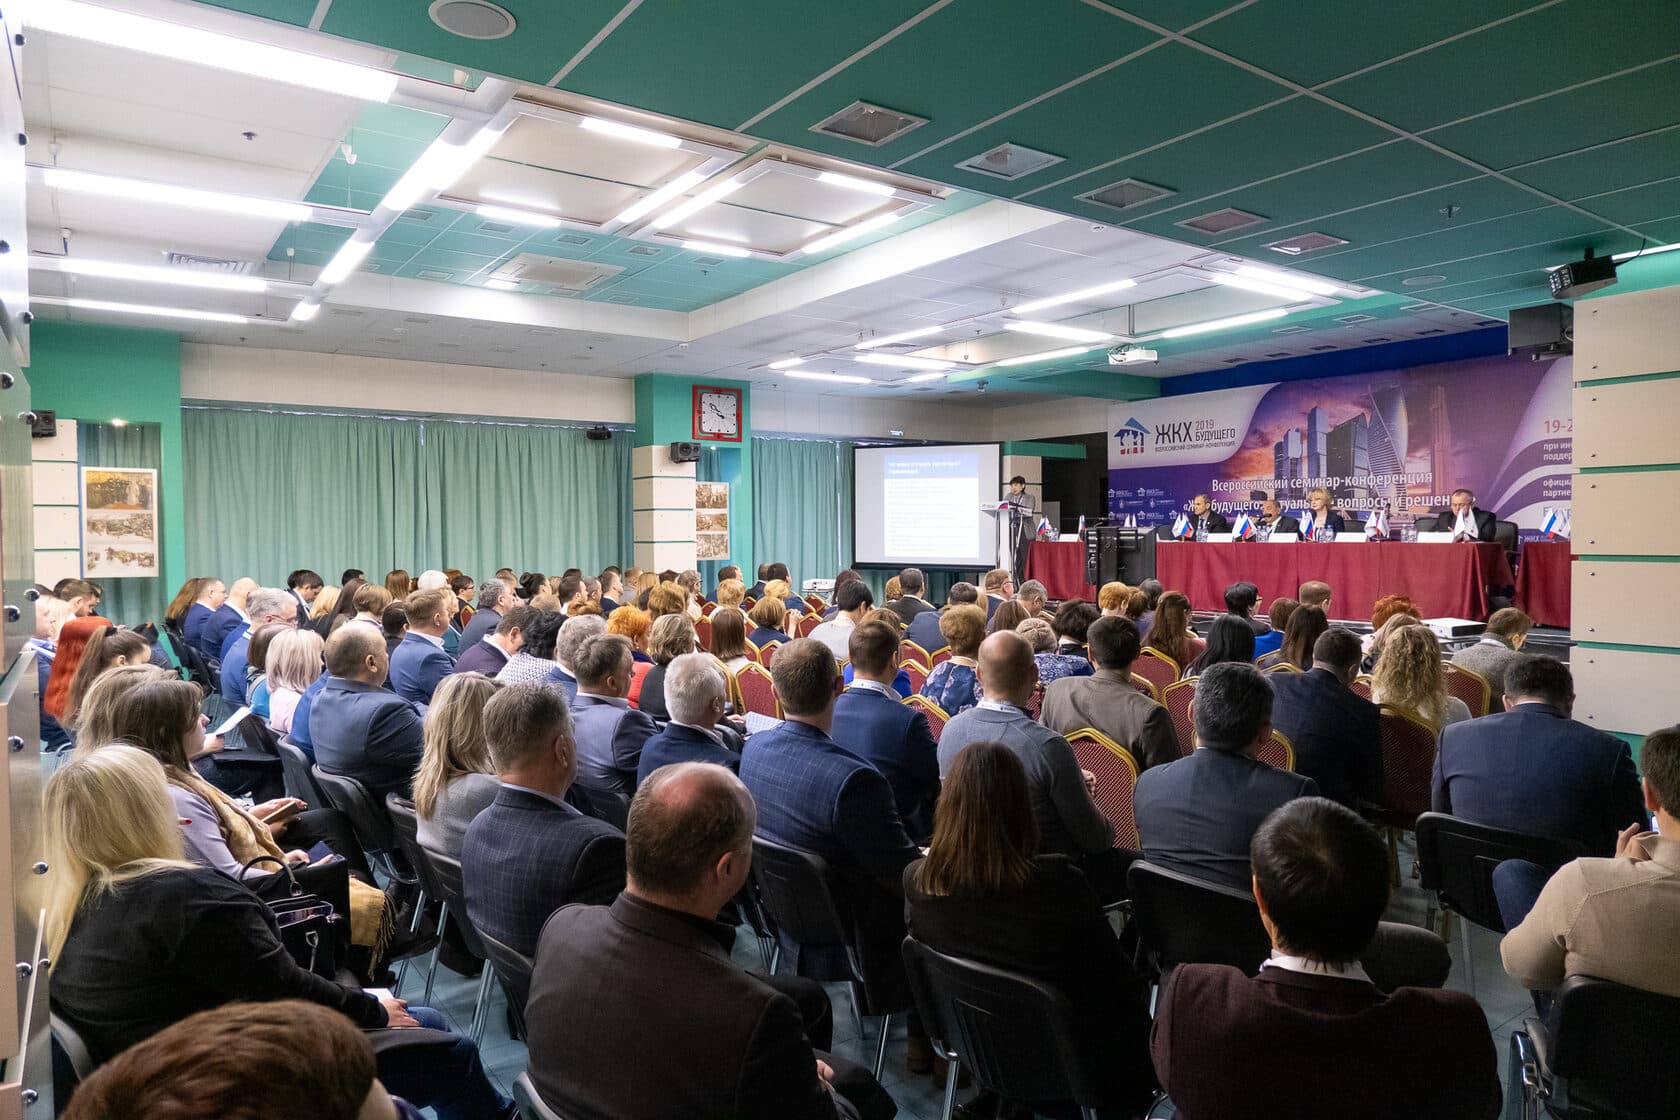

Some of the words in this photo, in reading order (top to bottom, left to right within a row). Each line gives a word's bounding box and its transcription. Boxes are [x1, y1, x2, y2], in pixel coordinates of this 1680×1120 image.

[1195, 419, 1215, 431] 2019
[1155, 421, 1193, 445] ЖКХ
[1195, 428, 1236, 442] БУДУЩЕГО
[1543, 443, 1559, 451] при
[1212, 475, 1288, 493] Всероссийский
[1290, 471, 1433, 491] семинар-конференция
[1337, 496, 1390, 510] вопросы
[1394, 496, 1402, 506] и
